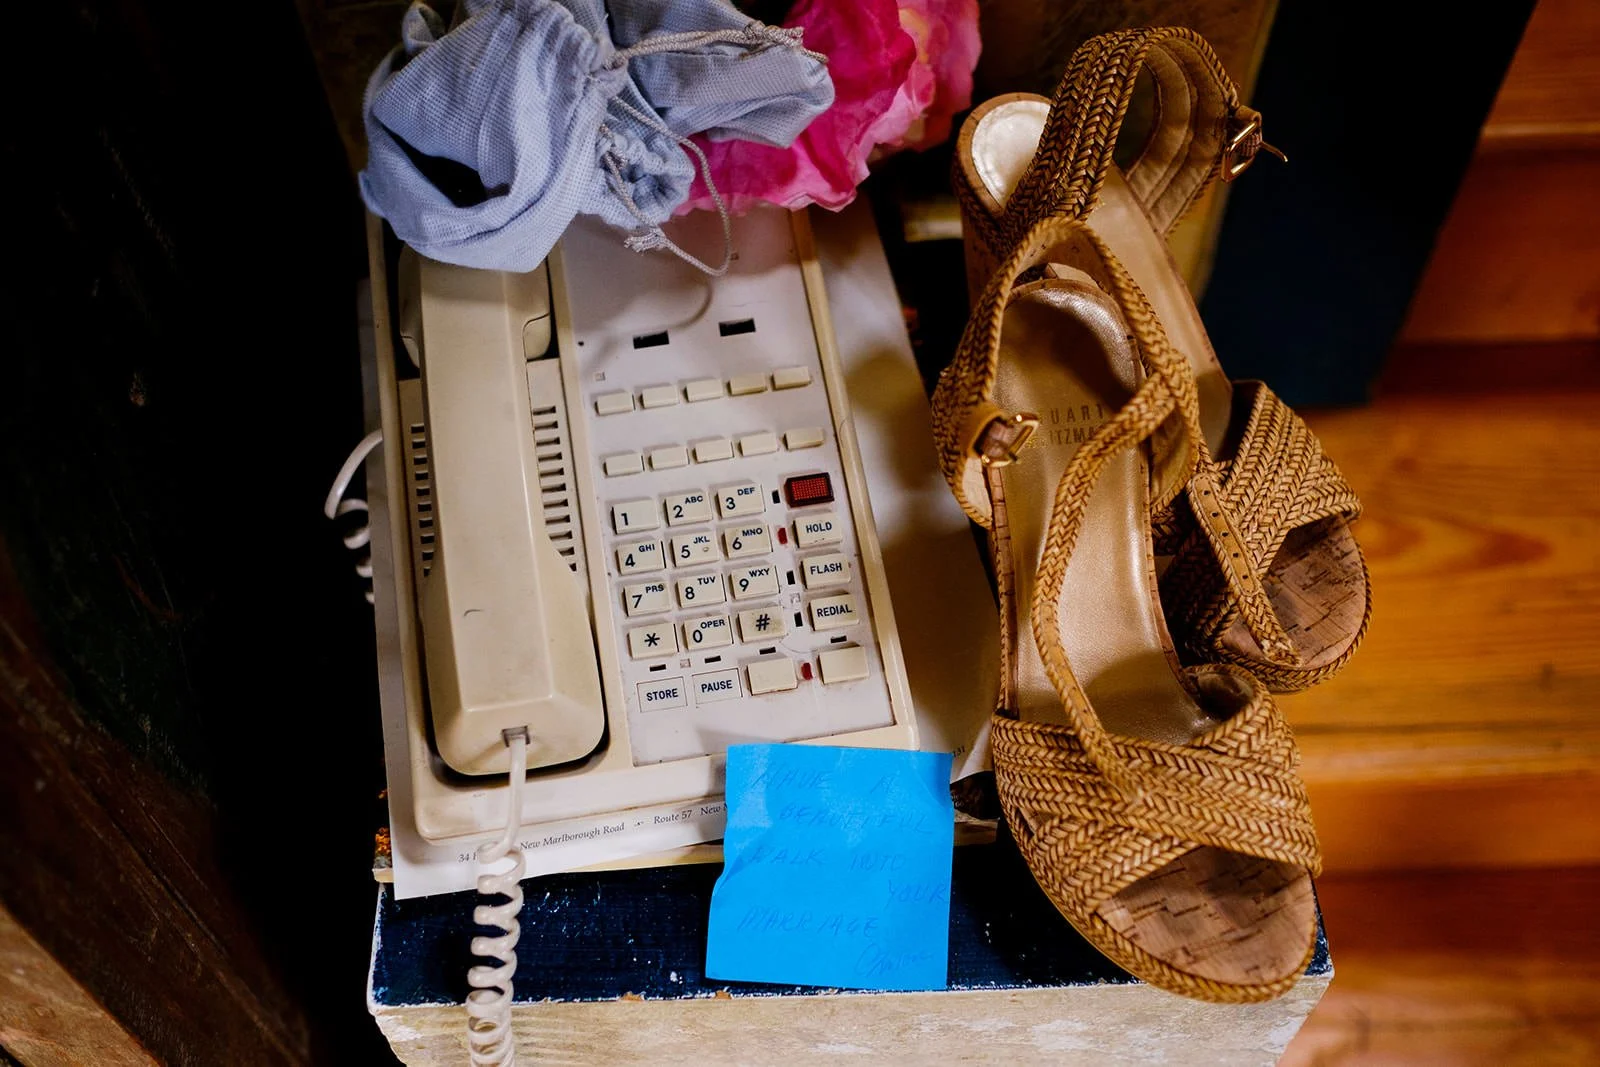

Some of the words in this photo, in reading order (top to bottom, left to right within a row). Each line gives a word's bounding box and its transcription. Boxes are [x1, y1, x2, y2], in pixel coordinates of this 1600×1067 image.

[1050, 403, 1104, 425] UART
[673, 504, 685, 519] 2
[684, 494, 704, 504] ABC
[725, 496, 737, 511] 3
[737, 486, 756, 497] DEF
[621, 512, 629, 526] 1
[805, 521, 833, 535] HOLD
[680, 545, 691, 559] 5
[693, 535, 710, 545] JKL
[732, 537, 743, 551] 6
[742, 527, 764, 537] MNO
[624, 553, 636, 568] 4
[638, 543, 656, 553] GHI
[738, 578, 750, 592] 9
[749, 567, 770, 578] WXY
[810, 562, 843, 576] FLASH
[632, 594, 643, 609] 7
[645, 583, 665, 594] PRS
[684, 586, 696, 600] 8
[697, 576, 716, 586] TUV
[816, 604, 853, 618] REDIAL
[692, 629, 703, 644] 0
[700, 618, 726, 630] OPER
[646, 687, 679, 702] STORE
[700, 679, 733, 693] PAUSE
[458, 853, 470, 863] 34
[520, 840, 541, 851] New
[542, 826, 601, 847] Marlborough
[602, 822, 625, 834] Road
[653, 813, 680, 825] Route
[681, 809, 693, 820] 57
[700, 804, 721, 816] New
[885, 878, 950, 909] YOUR
